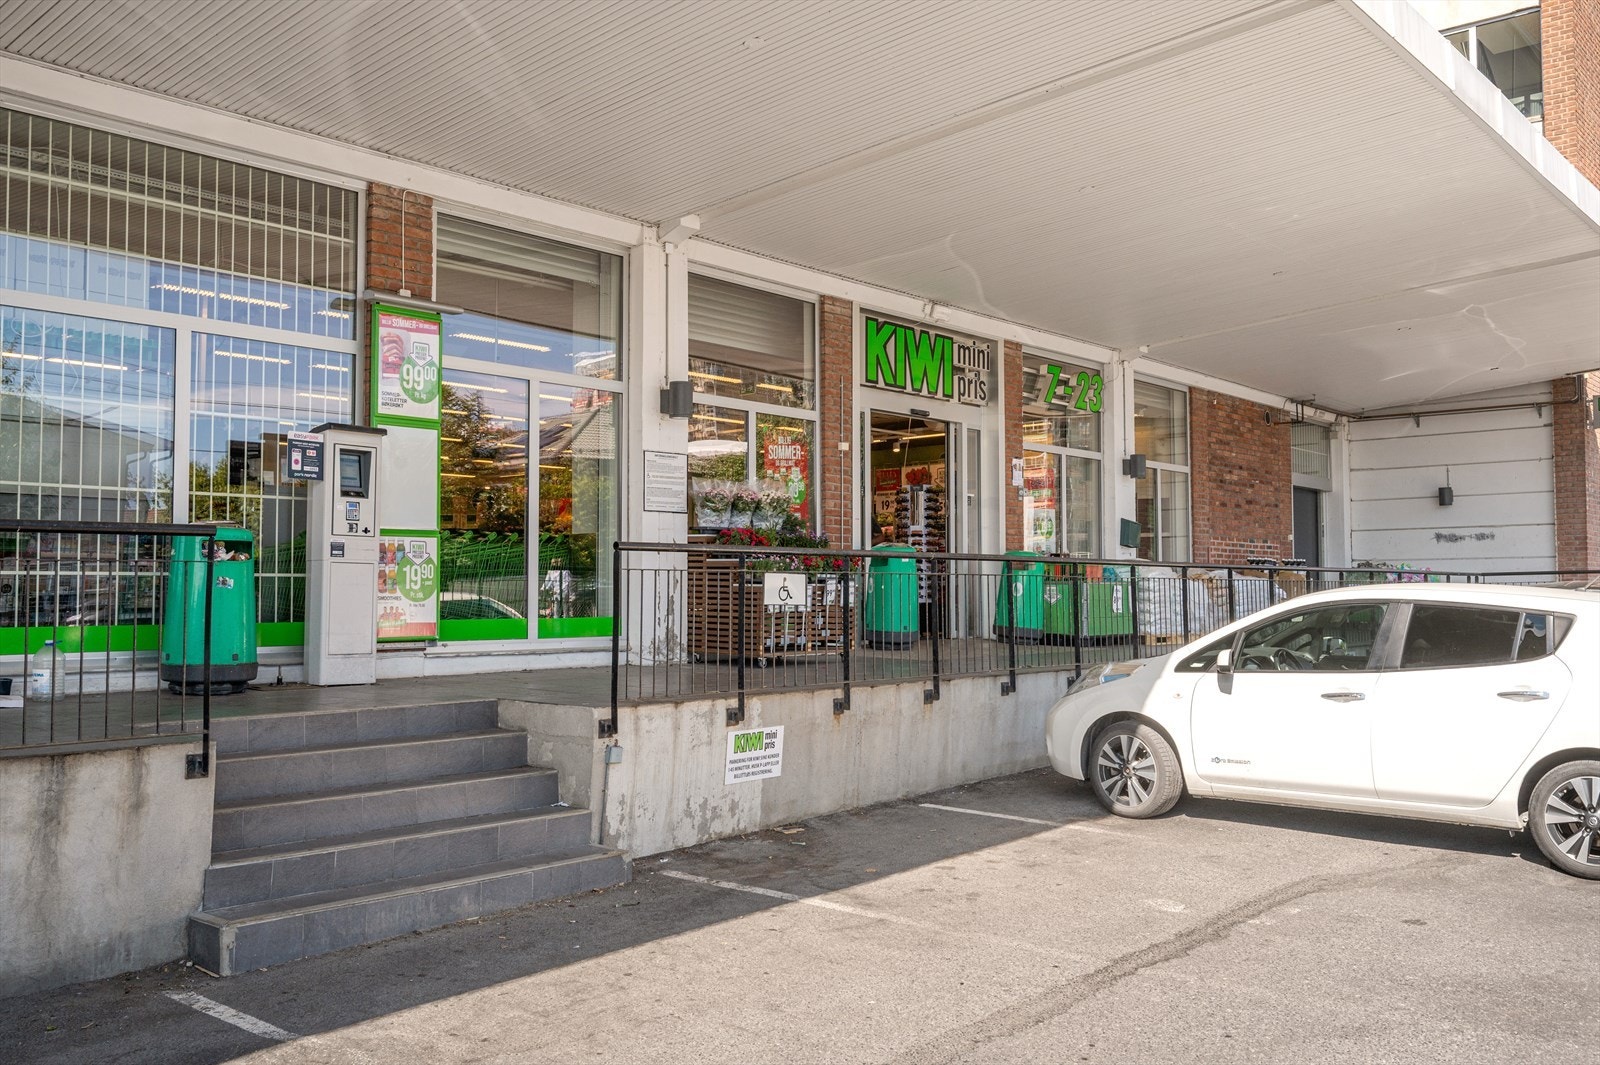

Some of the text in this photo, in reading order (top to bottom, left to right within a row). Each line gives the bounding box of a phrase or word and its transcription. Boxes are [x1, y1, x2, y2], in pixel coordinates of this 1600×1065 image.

[865, 316, 954, 399] KIWI
[957, 341, 990, 371] mini
[958, 372, 987, 402] pris
[734, 731, 764, 754] KIWI
[764, 740, 776, 751] pris
[765, 729, 778, 740] mini
